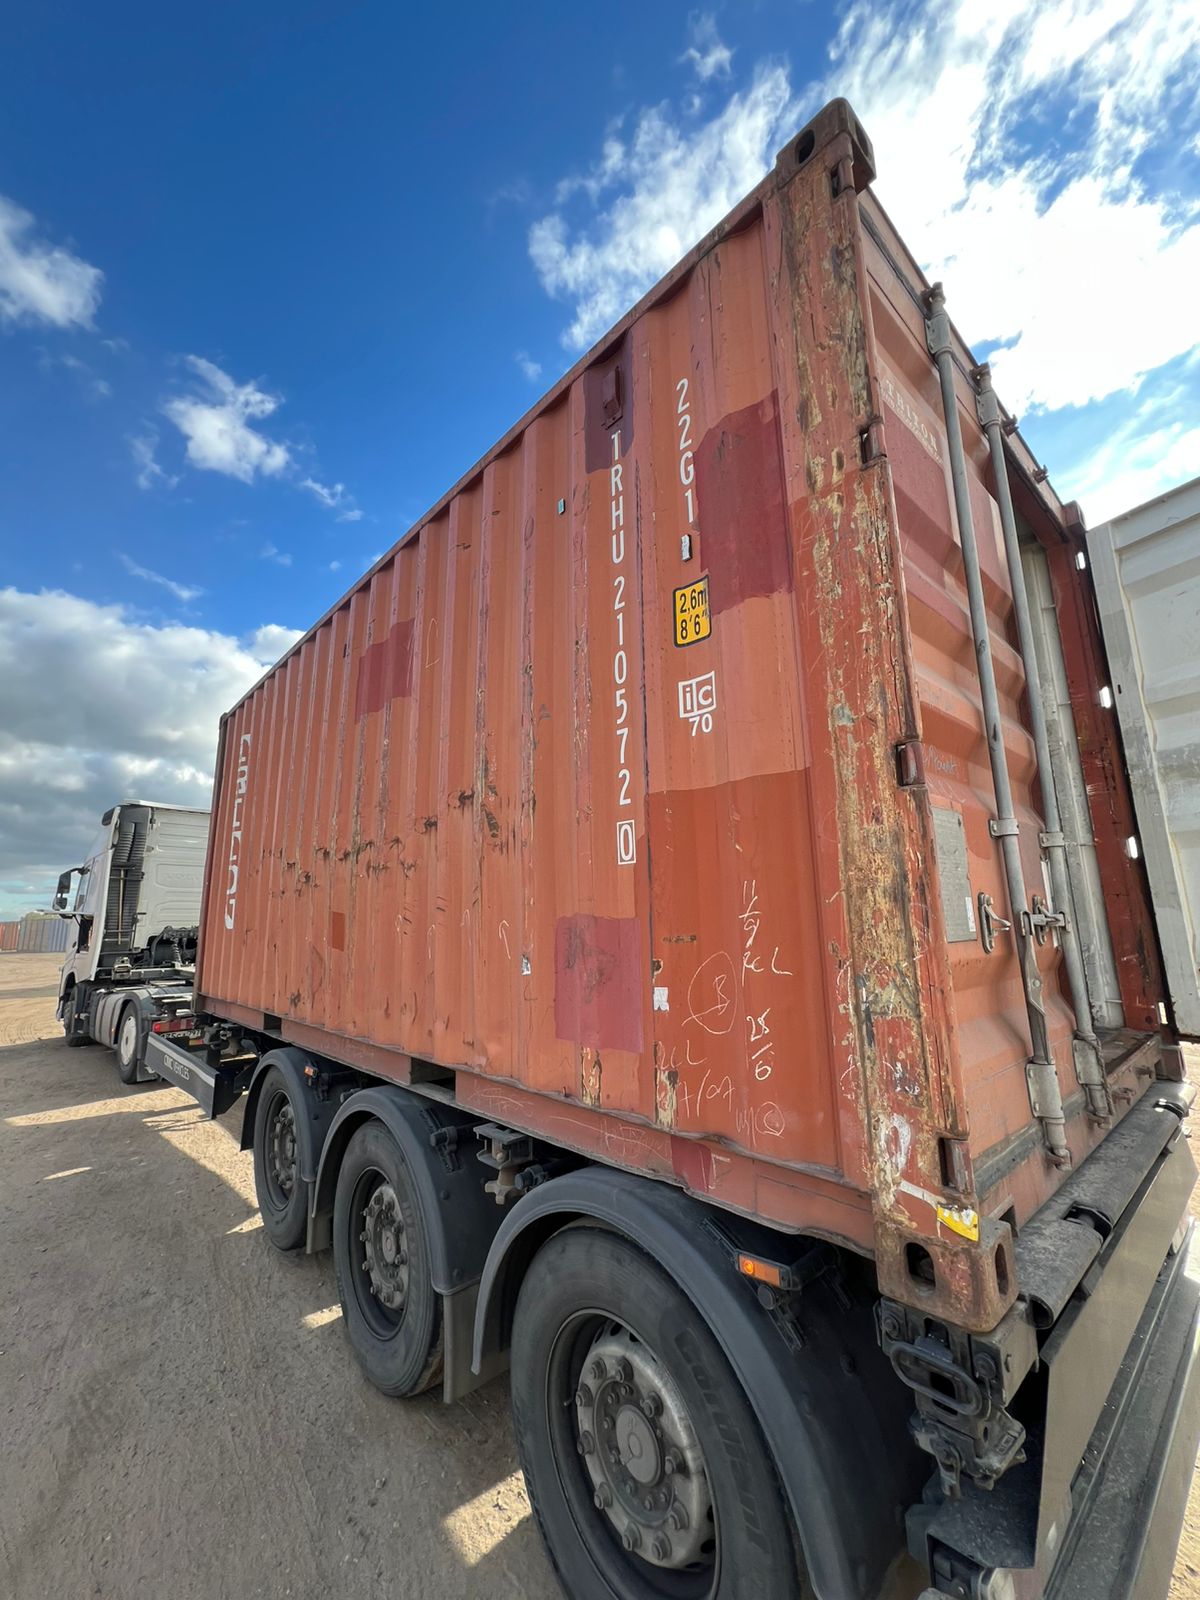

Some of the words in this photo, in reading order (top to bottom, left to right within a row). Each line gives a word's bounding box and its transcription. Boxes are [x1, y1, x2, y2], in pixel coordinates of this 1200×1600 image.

[610, 430, 625, 564] TRHU
[676, 377, 695, 524] 22G1
[613, 576, 632, 806] 210572
[689, 714, 712, 737] 70
[617, 821, 636, 863] 0
